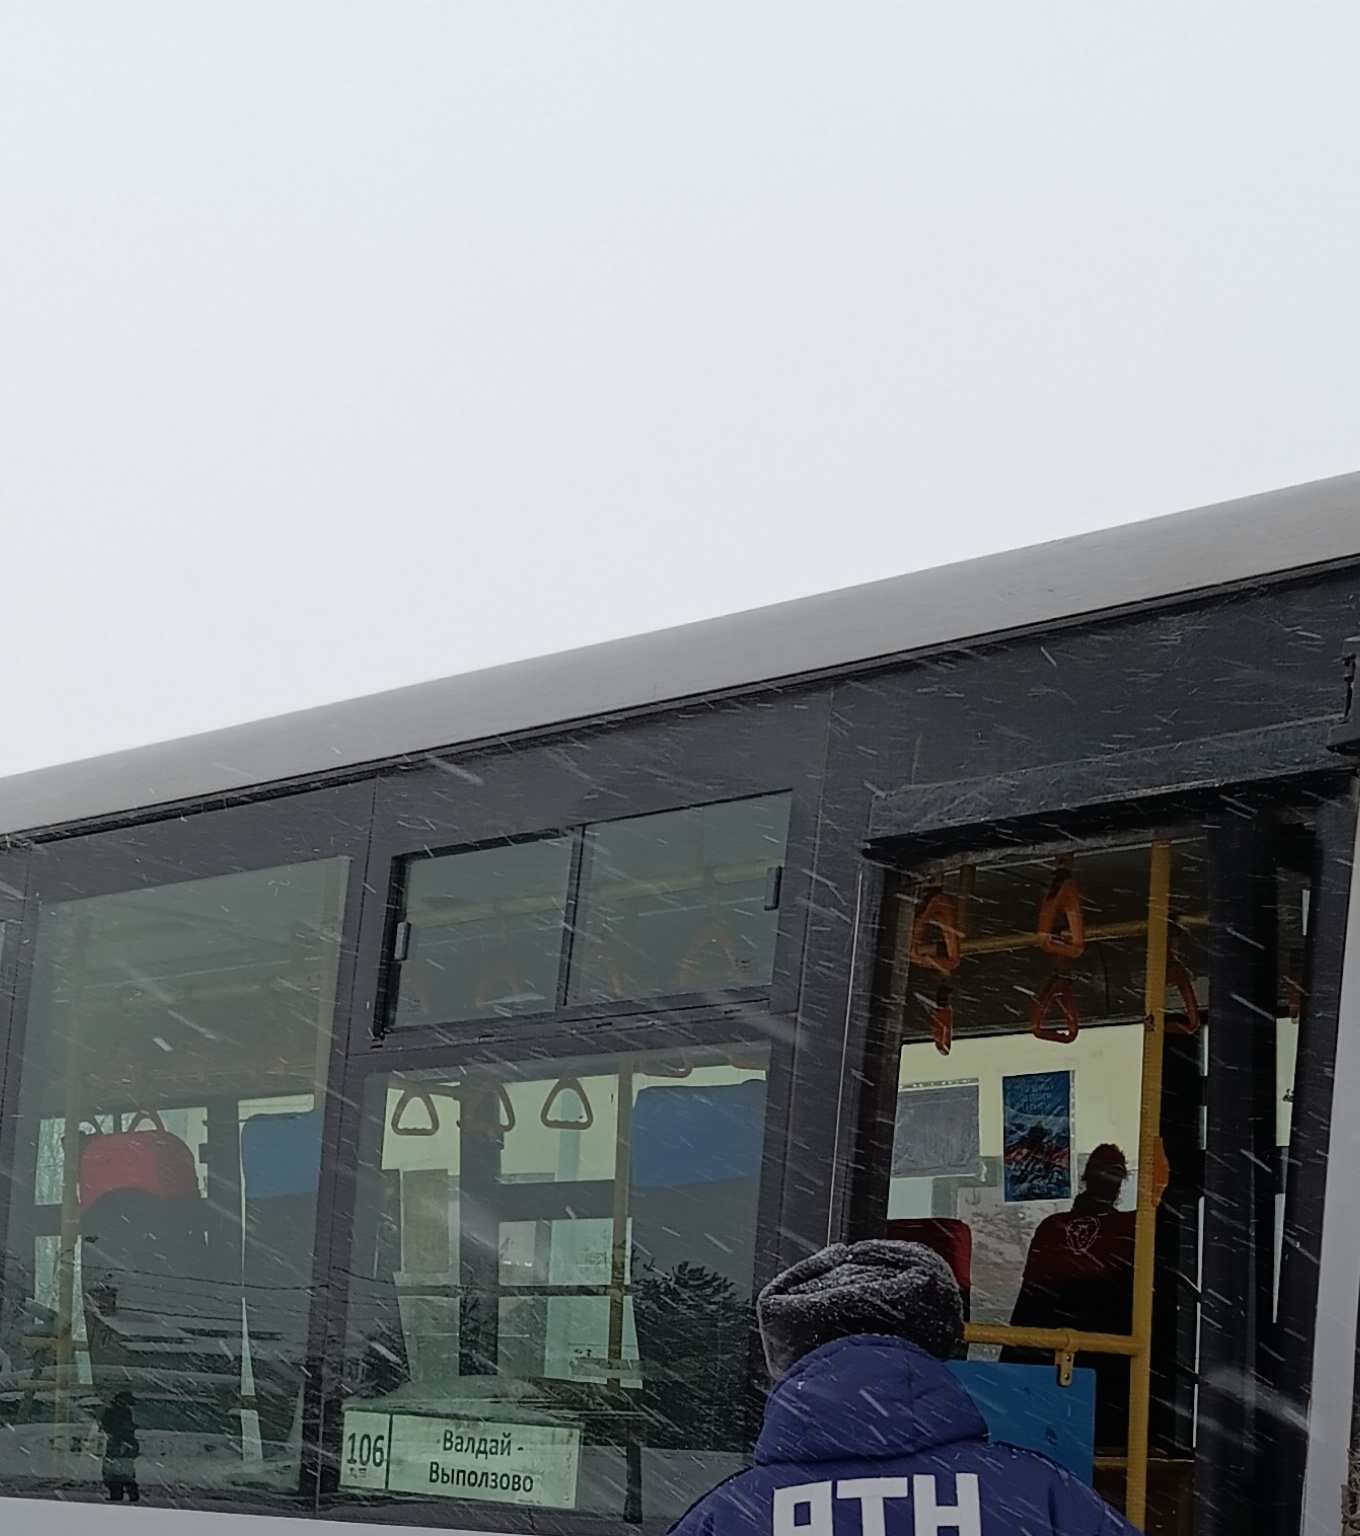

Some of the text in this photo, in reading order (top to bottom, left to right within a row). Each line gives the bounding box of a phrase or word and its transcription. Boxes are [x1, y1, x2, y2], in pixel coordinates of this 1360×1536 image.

[346, 1432, 385, 1467] 106
[443, 1429, 512, 1460] Валдай
[429, 1461, 534, 1492] Выползово
